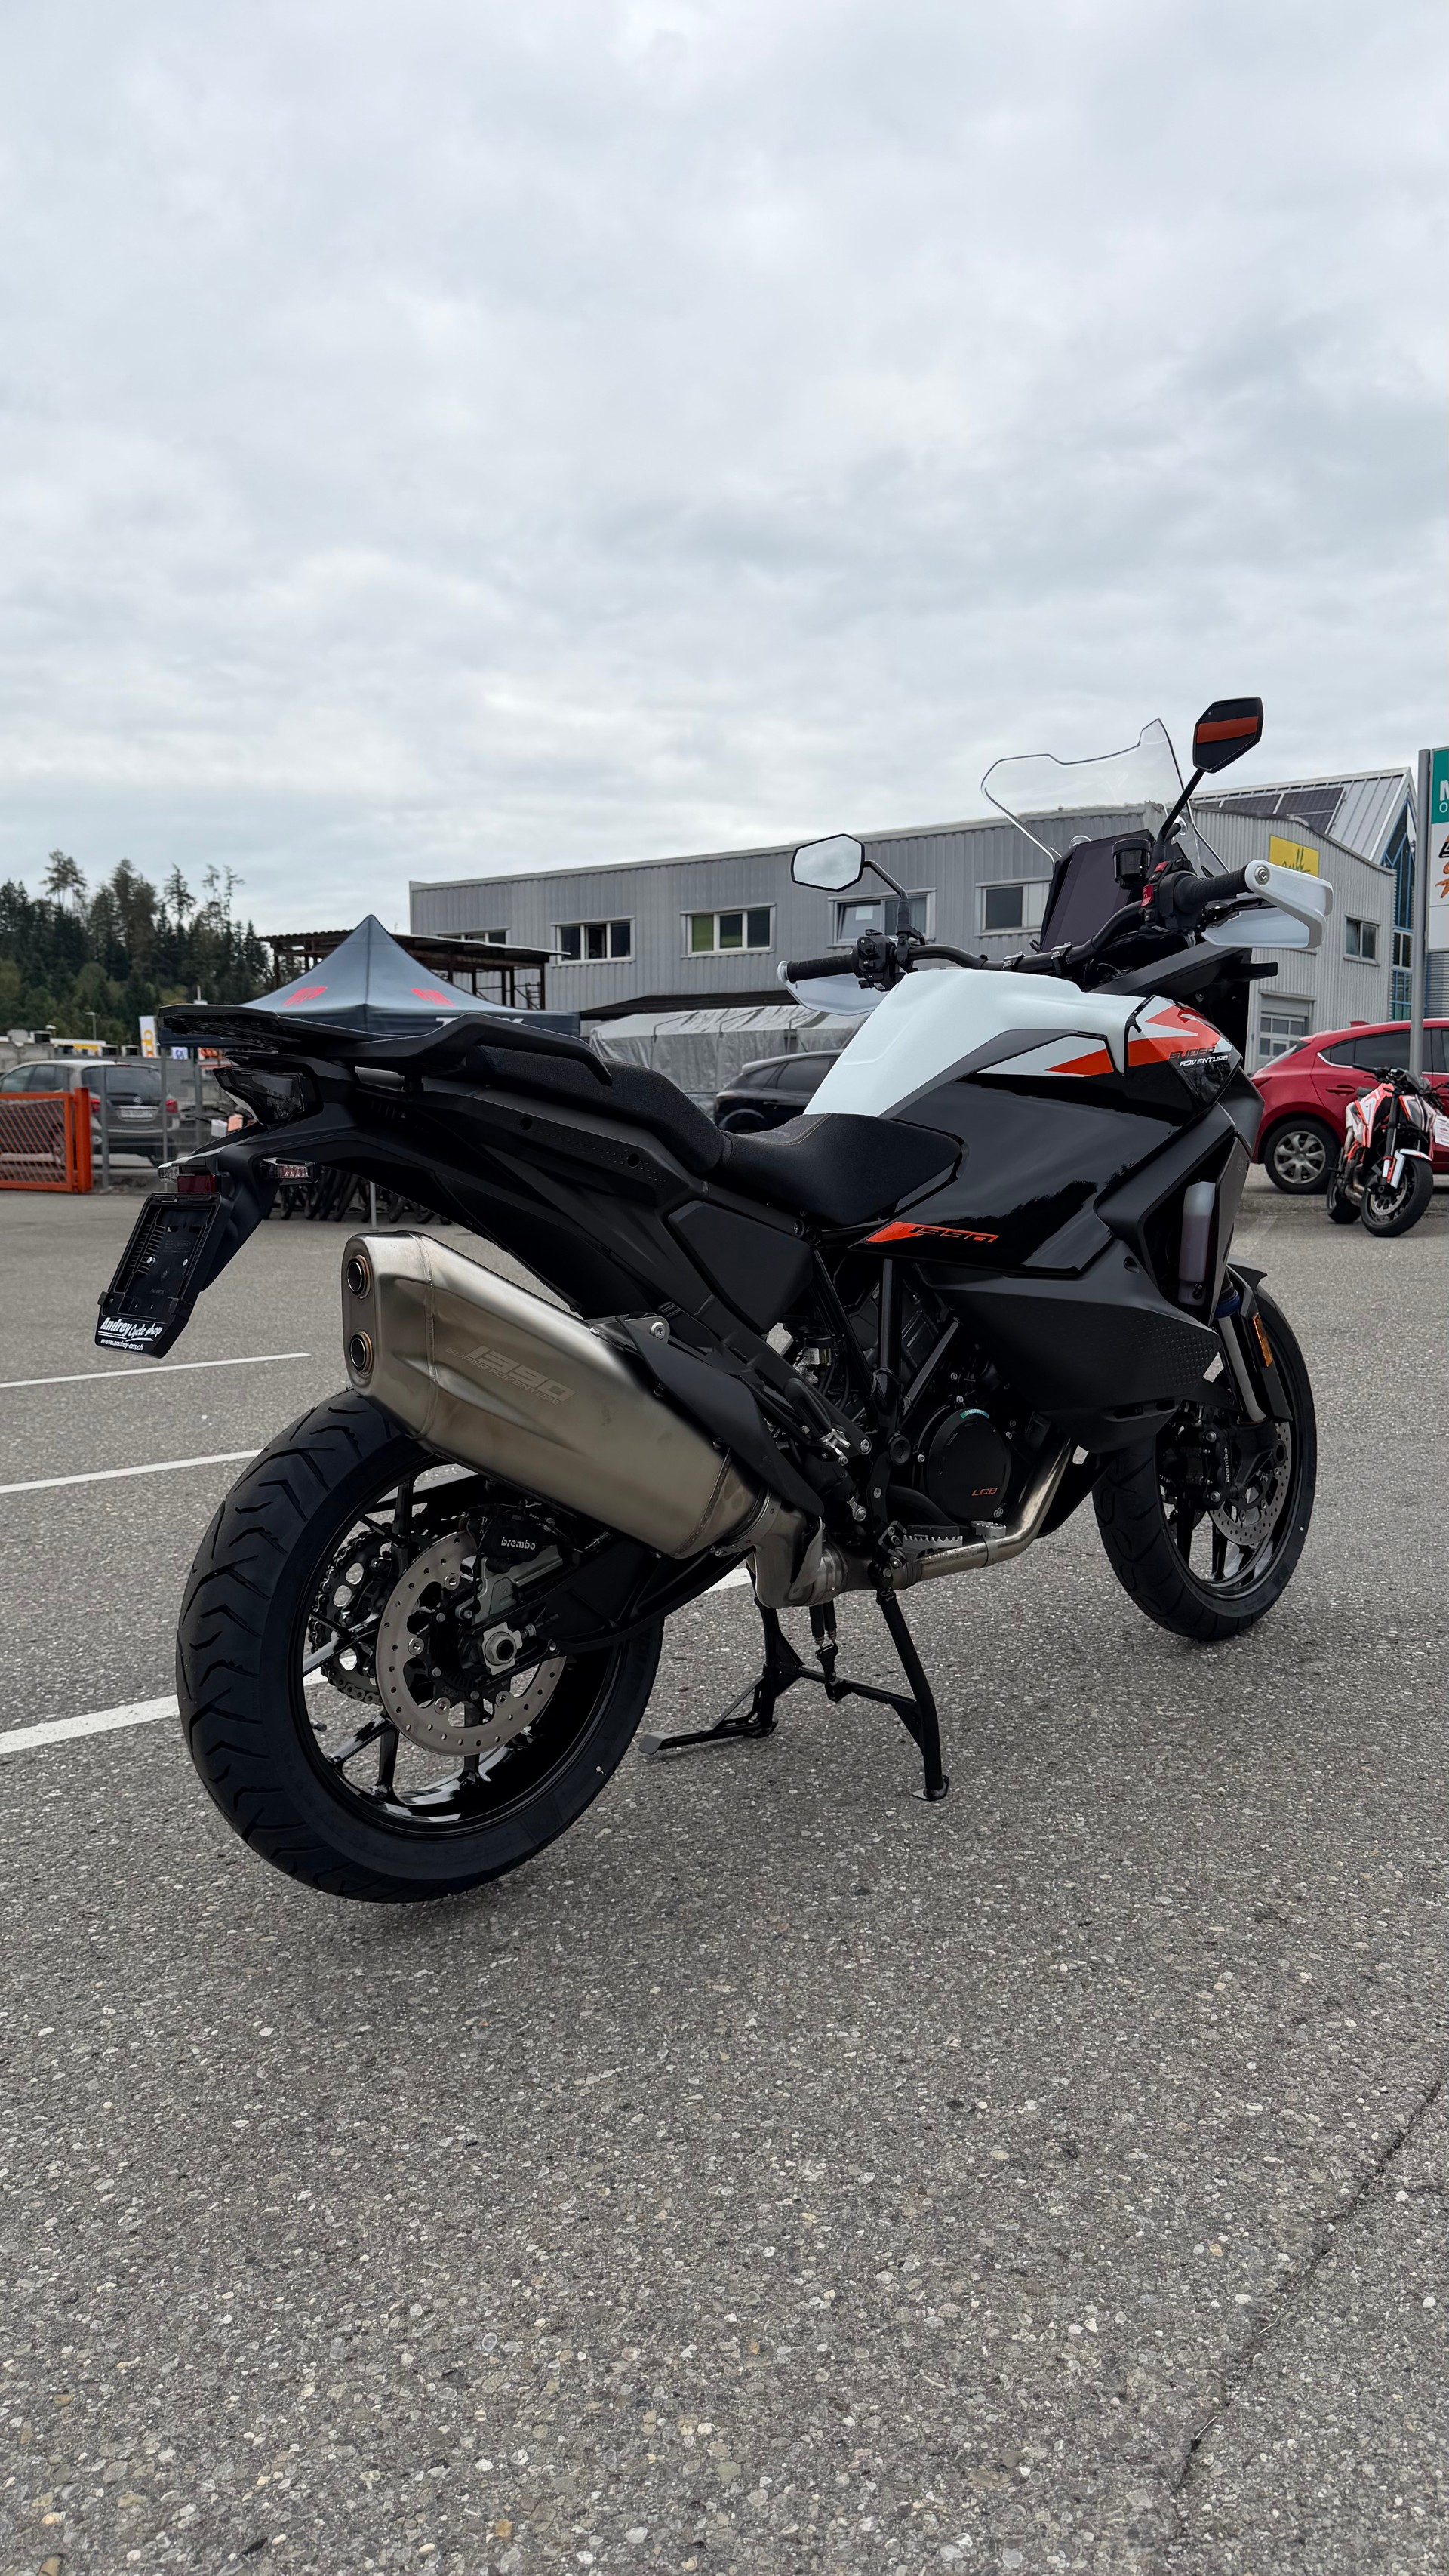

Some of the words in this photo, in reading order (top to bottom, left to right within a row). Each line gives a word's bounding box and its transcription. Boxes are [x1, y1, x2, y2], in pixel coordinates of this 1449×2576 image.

[1170, 1046, 1215, 1059] SUPER
[1179, 1055, 1229, 1067] ADVENTURE
[100, 1317, 133, 1337] Andrey
[128, 1323, 147, 1339] Cycle
[144, 1322, 164, 1338] shop
[445, 1347, 489, 1370] SUPER
[488, 1369, 561, 1405] ADVENTURE
[466, 1345, 576, 1402] 1390
[971, 1488, 998, 1496] LC8
[501, 1536, 536, 1550] brembo
